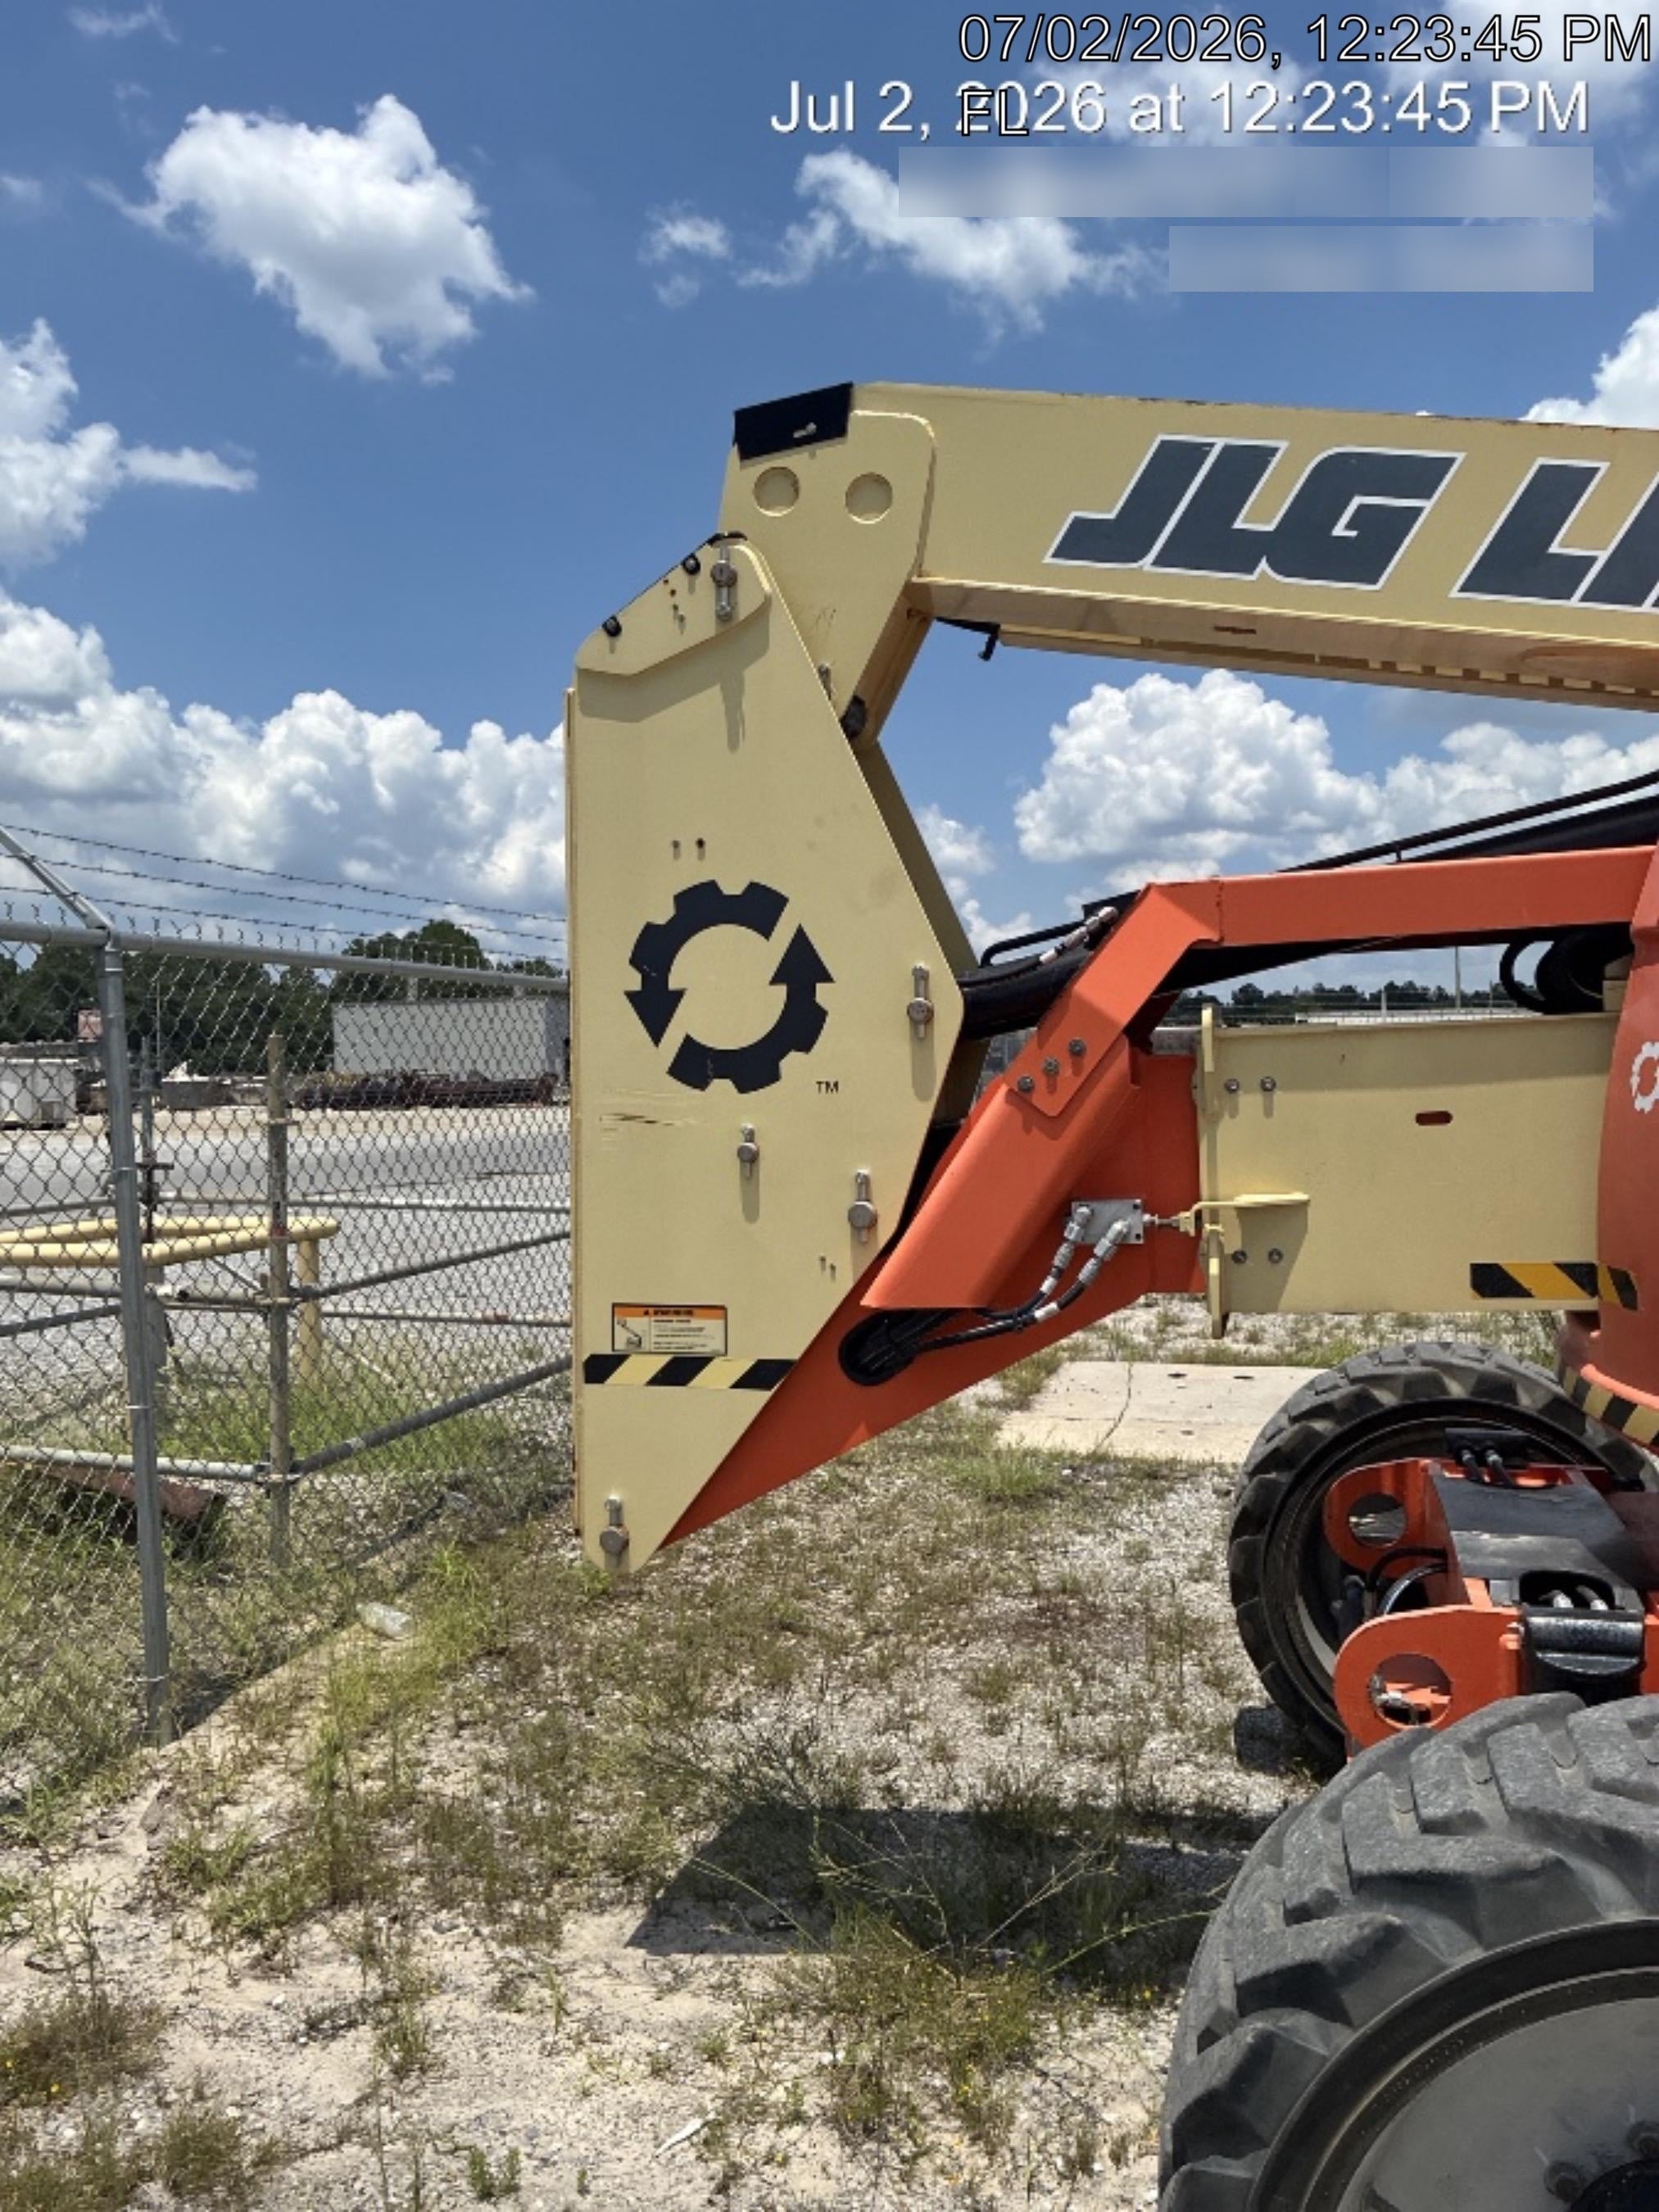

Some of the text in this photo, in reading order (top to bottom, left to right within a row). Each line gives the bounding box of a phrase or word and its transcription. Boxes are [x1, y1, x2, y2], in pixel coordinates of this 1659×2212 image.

[1043, 433, 1659, 614] JLG LI
[815, 1081, 839, 1095] TM
